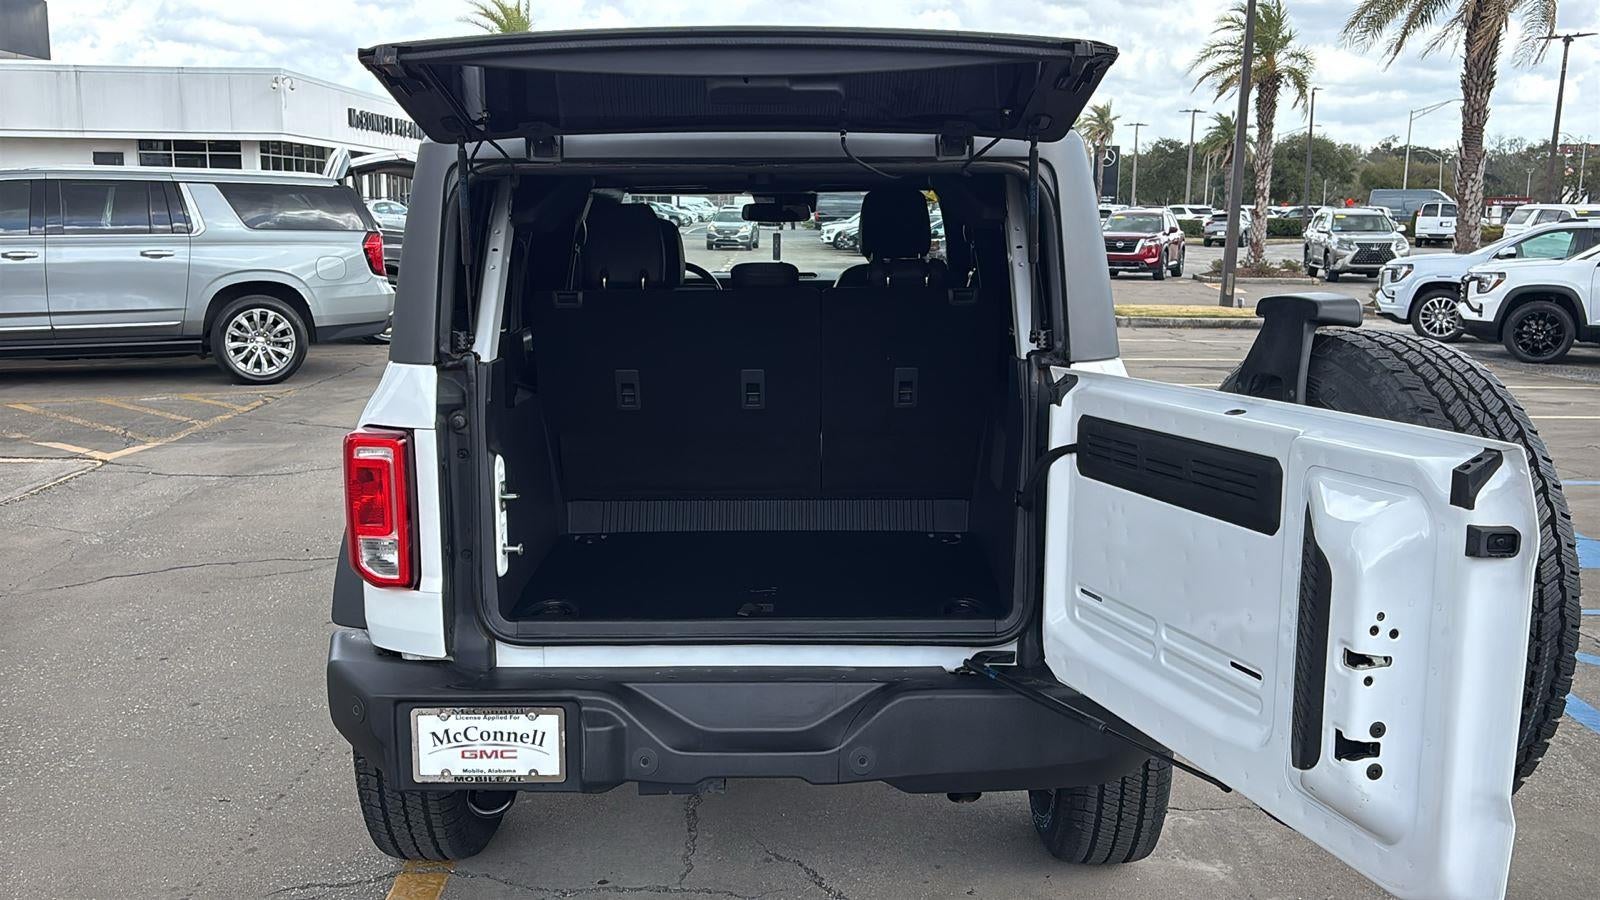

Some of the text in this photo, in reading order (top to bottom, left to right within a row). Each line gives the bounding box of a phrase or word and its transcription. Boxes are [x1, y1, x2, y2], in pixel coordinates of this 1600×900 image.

[347, 107, 393, 135] McCONNELL
[429, 726, 546, 747] McConnell
[461, 749, 518, 759] GMC
